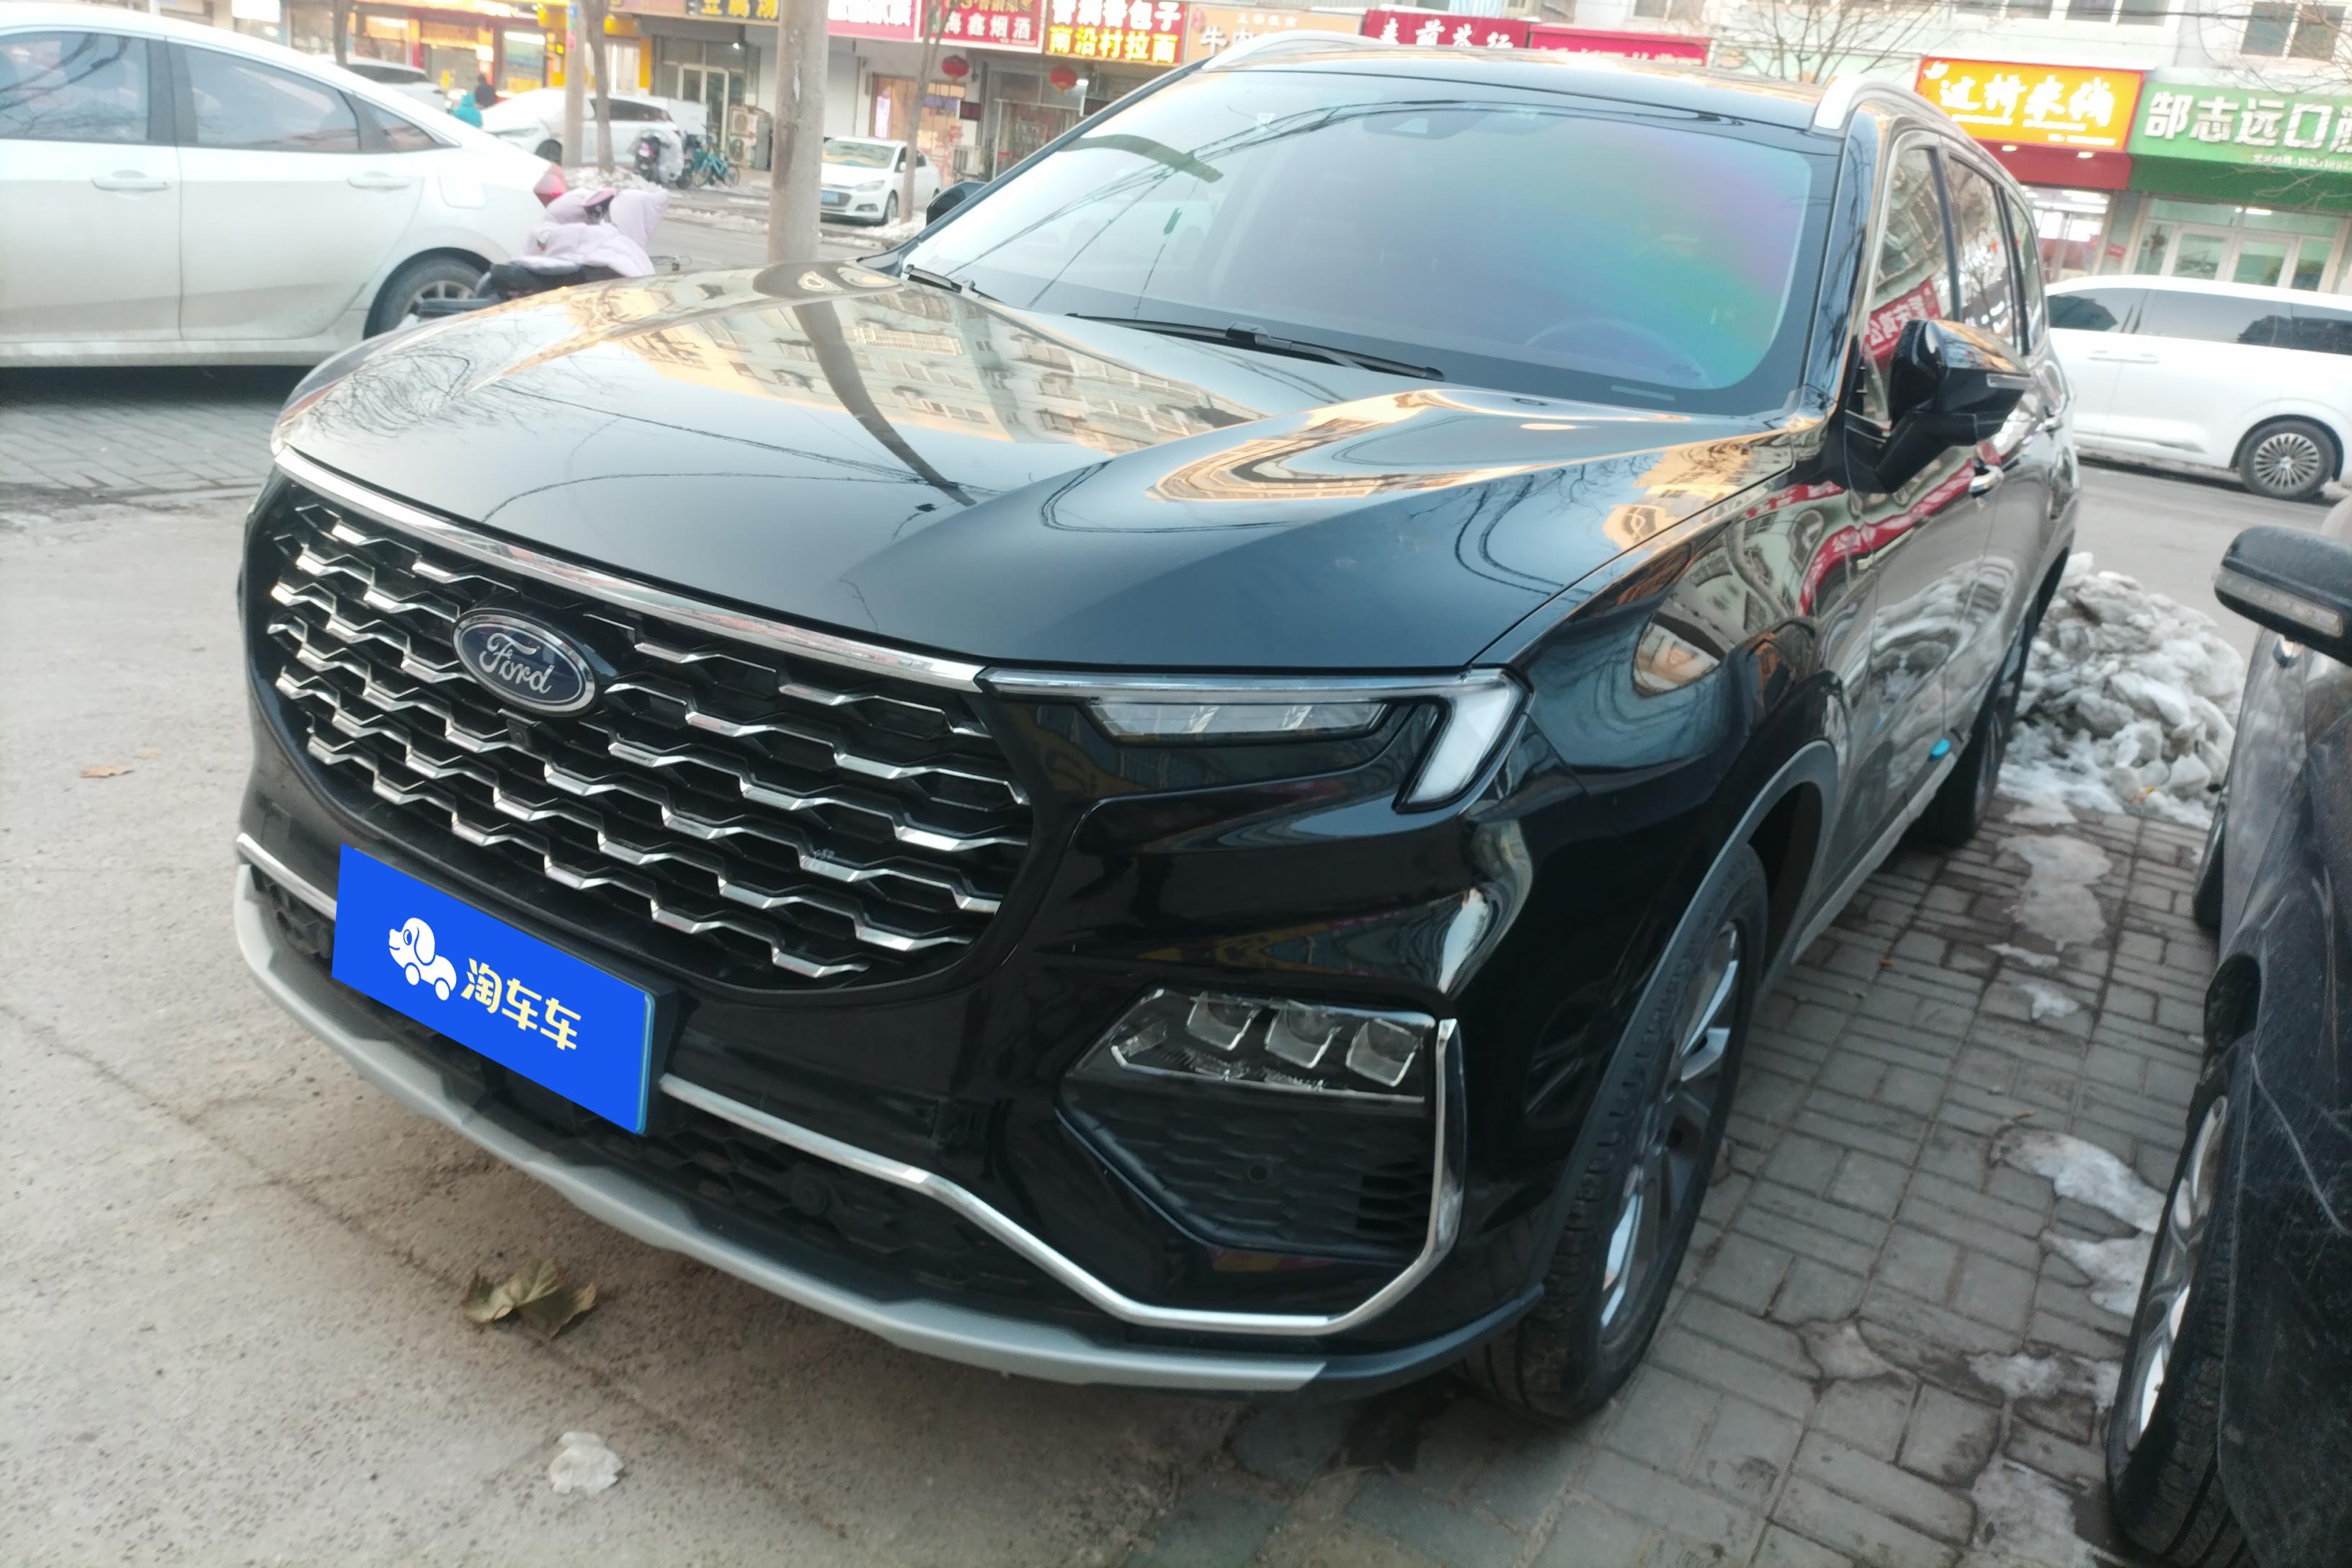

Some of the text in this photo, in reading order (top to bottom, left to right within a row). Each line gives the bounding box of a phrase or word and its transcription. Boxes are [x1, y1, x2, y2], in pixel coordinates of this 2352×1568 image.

[944, 11, 1031, 40] 海鑫烟酒
[479, 633, 555, 694] Ford
